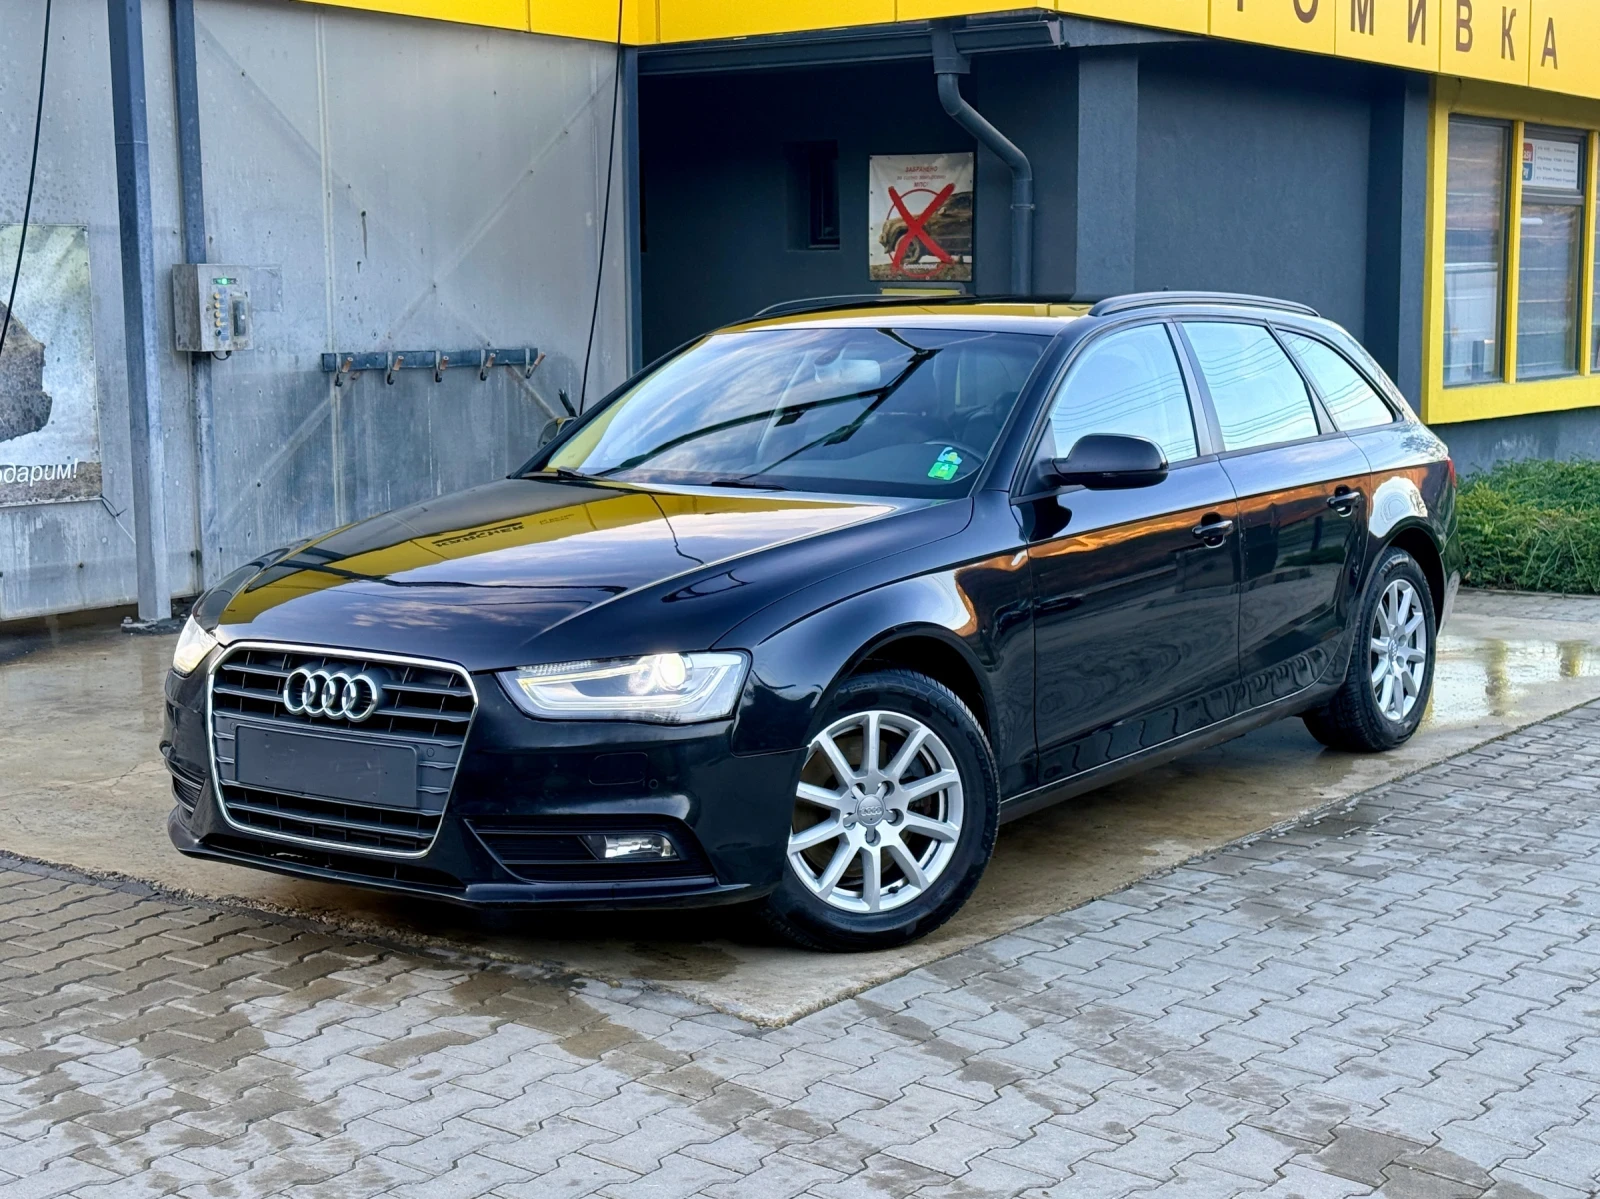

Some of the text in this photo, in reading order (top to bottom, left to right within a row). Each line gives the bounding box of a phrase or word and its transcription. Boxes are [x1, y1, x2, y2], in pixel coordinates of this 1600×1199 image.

[1237, 0, 1559, 71] МИВКА
[905, 165, 938, 173] ЗАБРАНЕНО
[0, 457, 79, 487] дарим!
